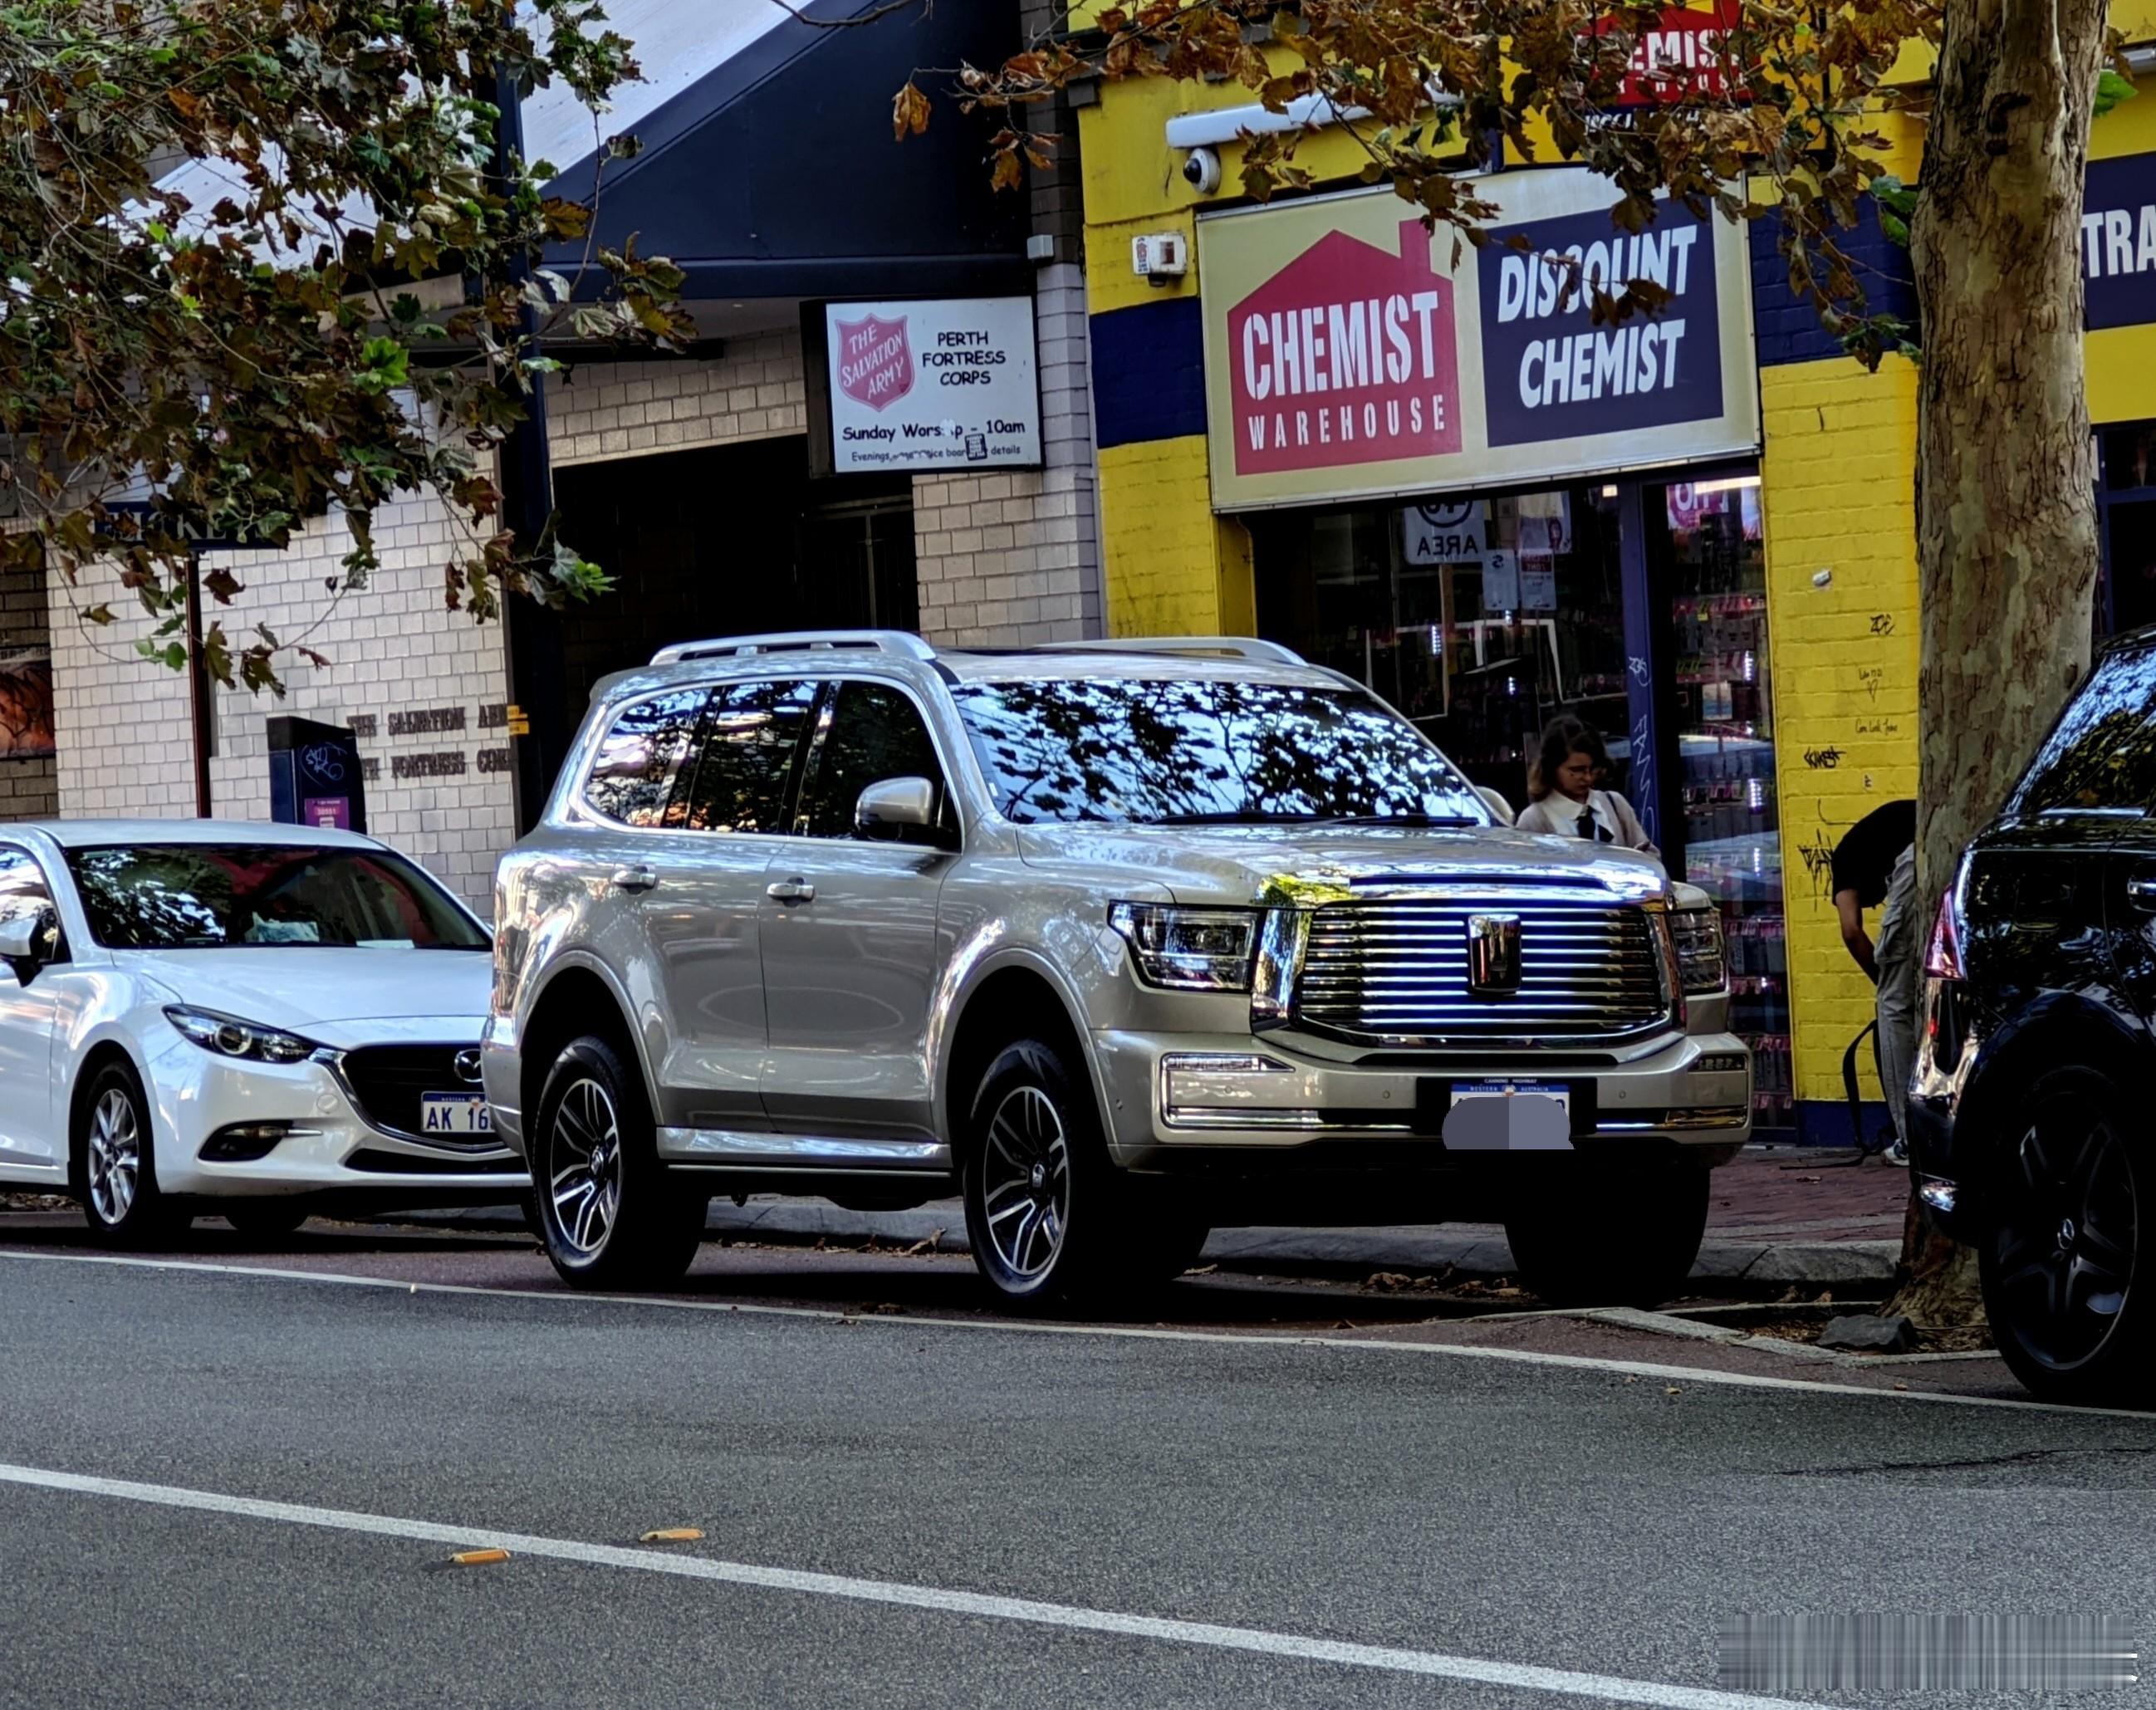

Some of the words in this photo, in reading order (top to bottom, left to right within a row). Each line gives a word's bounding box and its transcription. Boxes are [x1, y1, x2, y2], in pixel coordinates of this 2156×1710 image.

[2081, 204, 2156, 278] TRA
[850, 323, 877, 355] THE
[938, 331, 988, 347] PERTH
[1243, 291, 1438, 401] CHEMIST
[842, 328, 902, 388] SALVATION
[923, 350, 1006, 367] FORTRESS
[1519, 318, 1685, 409] CHEMIST
[868, 356, 904, 399] ARMY
[940, 371, 991, 385] CORPS
[842, 424, 896, 443] Sunday
[902, 423, 963, 440] Worsp
[986, 419, 1026, 434] 10am
[1248, 394, 1445, 452] WAREHOUSE
[946, 448, 967, 458] boar
[991, 444, 1021, 455] details
[387, 707, 465, 736] SALVATION
[390, 751, 465, 779] FORTRESS
[427, 1107, 452, 1129] AK
